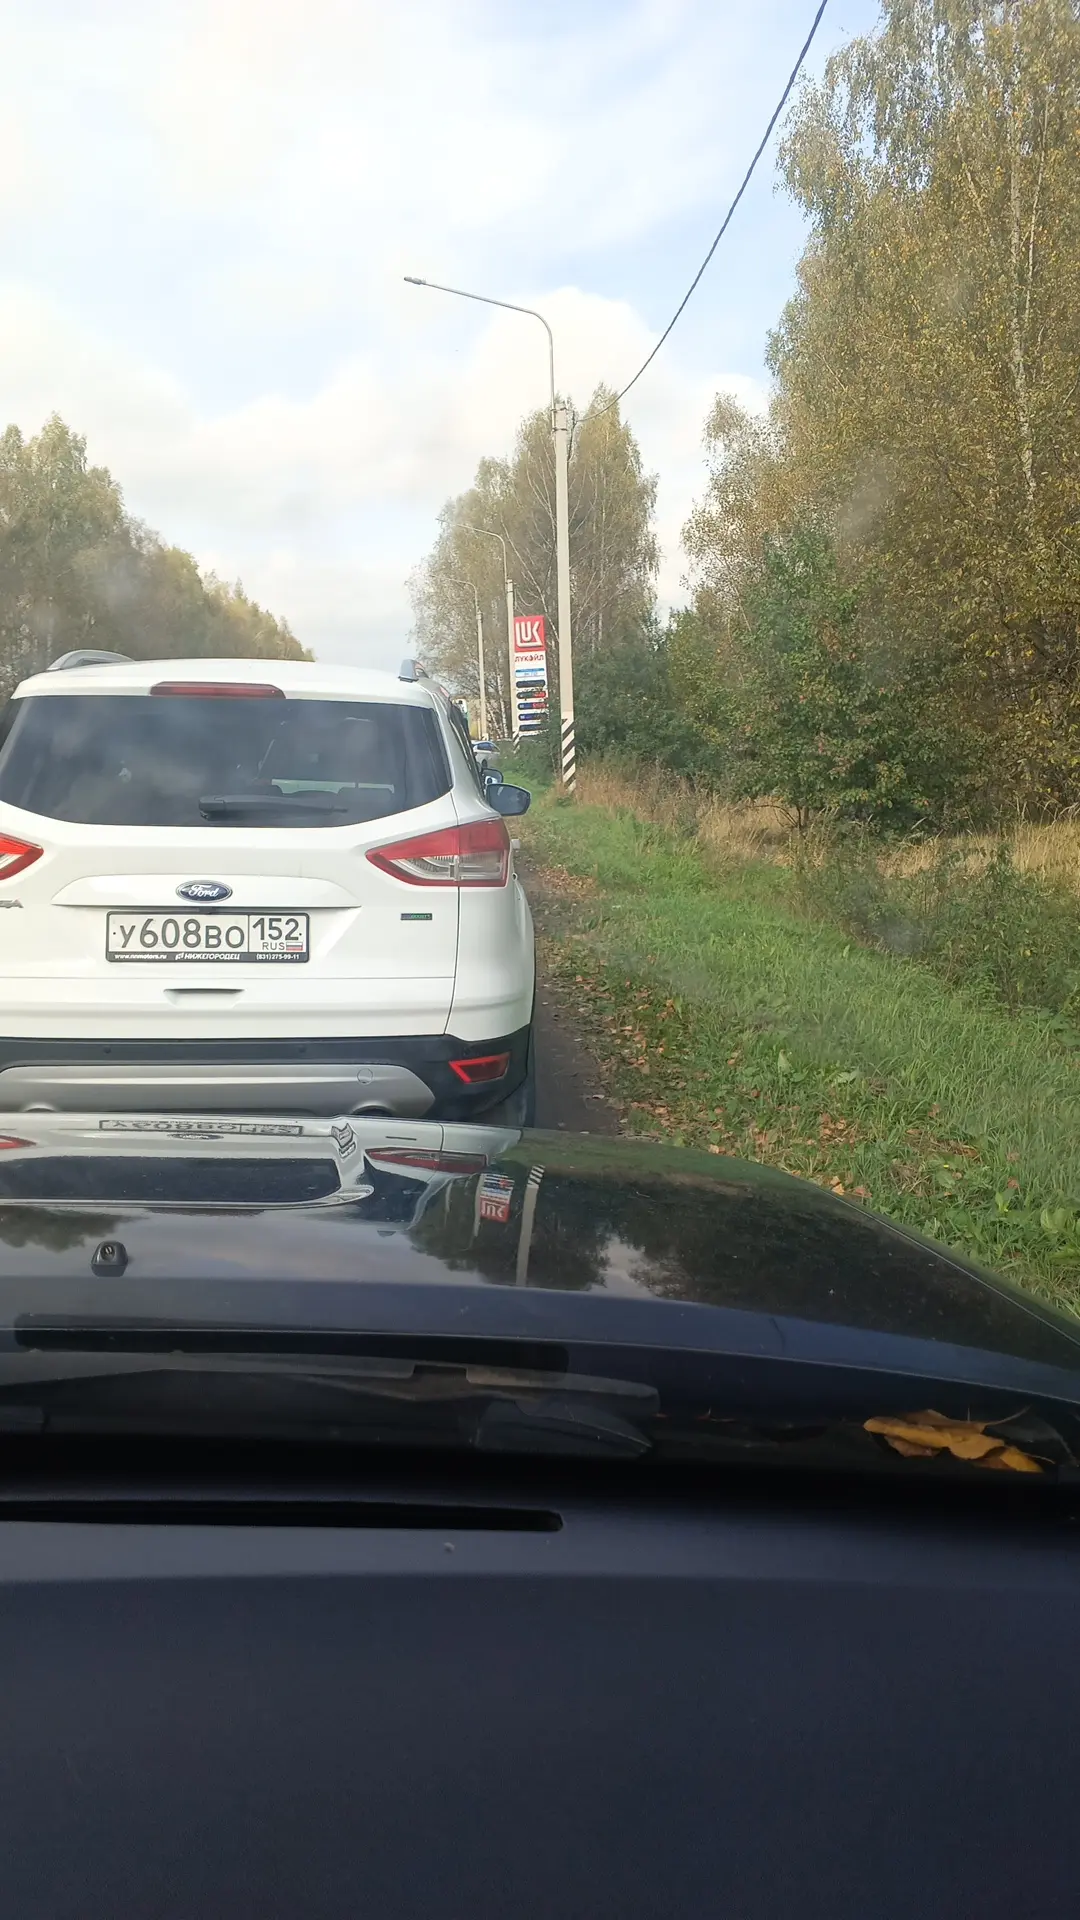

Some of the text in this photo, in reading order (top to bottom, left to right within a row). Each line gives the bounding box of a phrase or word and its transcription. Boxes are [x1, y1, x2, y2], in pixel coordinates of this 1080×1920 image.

[188, 884, 220, 898] Ford
[252, 917, 300, 941] 152
[262, 941, 285, 951] RUS
[184, 952, 240, 961] НИЖЕГОРОДЕЦ
